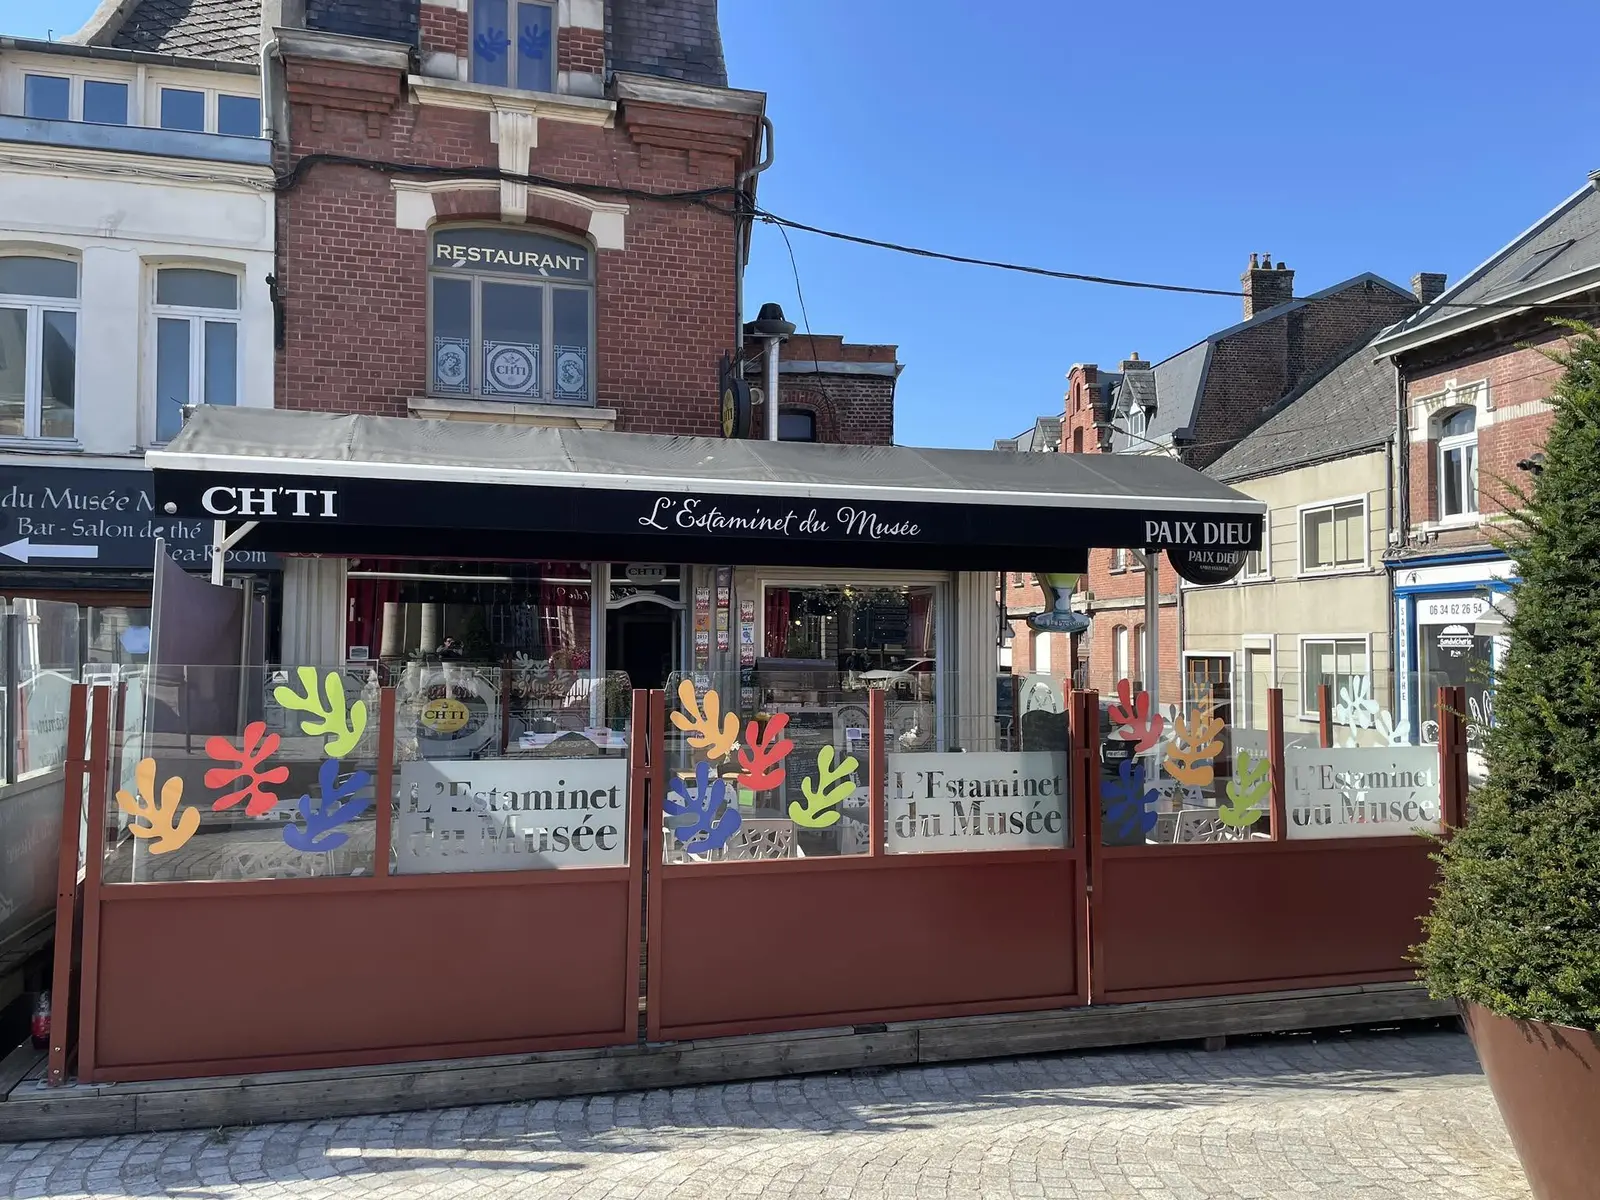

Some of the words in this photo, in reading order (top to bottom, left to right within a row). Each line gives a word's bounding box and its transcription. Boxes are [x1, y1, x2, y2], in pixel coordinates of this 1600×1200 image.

[436, 244, 584, 271] RESTAURANT
[1, 485, 35, 509] du
[40, 487, 131, 512] Musée
[201, 485, 338, 518] CH'TI
[17, 517, 56, 536] Bar
[72, 518, 135, 539] Salon
[139, 520, 165, 538] de
[170, 520, 202, 539] thé
[638, 496, 798, 536] L'Estaminet
[799, 508, 829, 534] du
[836, 506, 921, 539] Musée
[1145, 520, 1198, 544] PAIX
[1203, 522, 1253, 545] DIEU
[1188, 550, 1214, 563] PAIX
[1216, 552, 1239, 564] DIEU
[1430, 605, 1438, 615] 06
[1440, 604, 1449, 615] 34
[1451, 604, 1460, 614] 62
[1462, 603, 1471, 614] 26
[1473, 603, 1482, 613] 54
[893, 769, 1063, 800] L'Estaminet
[1292, 763, 1436, 791] L'Estaminet
[406, 779, 622, 814] L'Estaminet
[1338, 791, 1436, 825] Musée
[895, 801, 945, 839] du
[950, 800, 1063, 837] Musée
[477, 814, 618, 856] Musée
